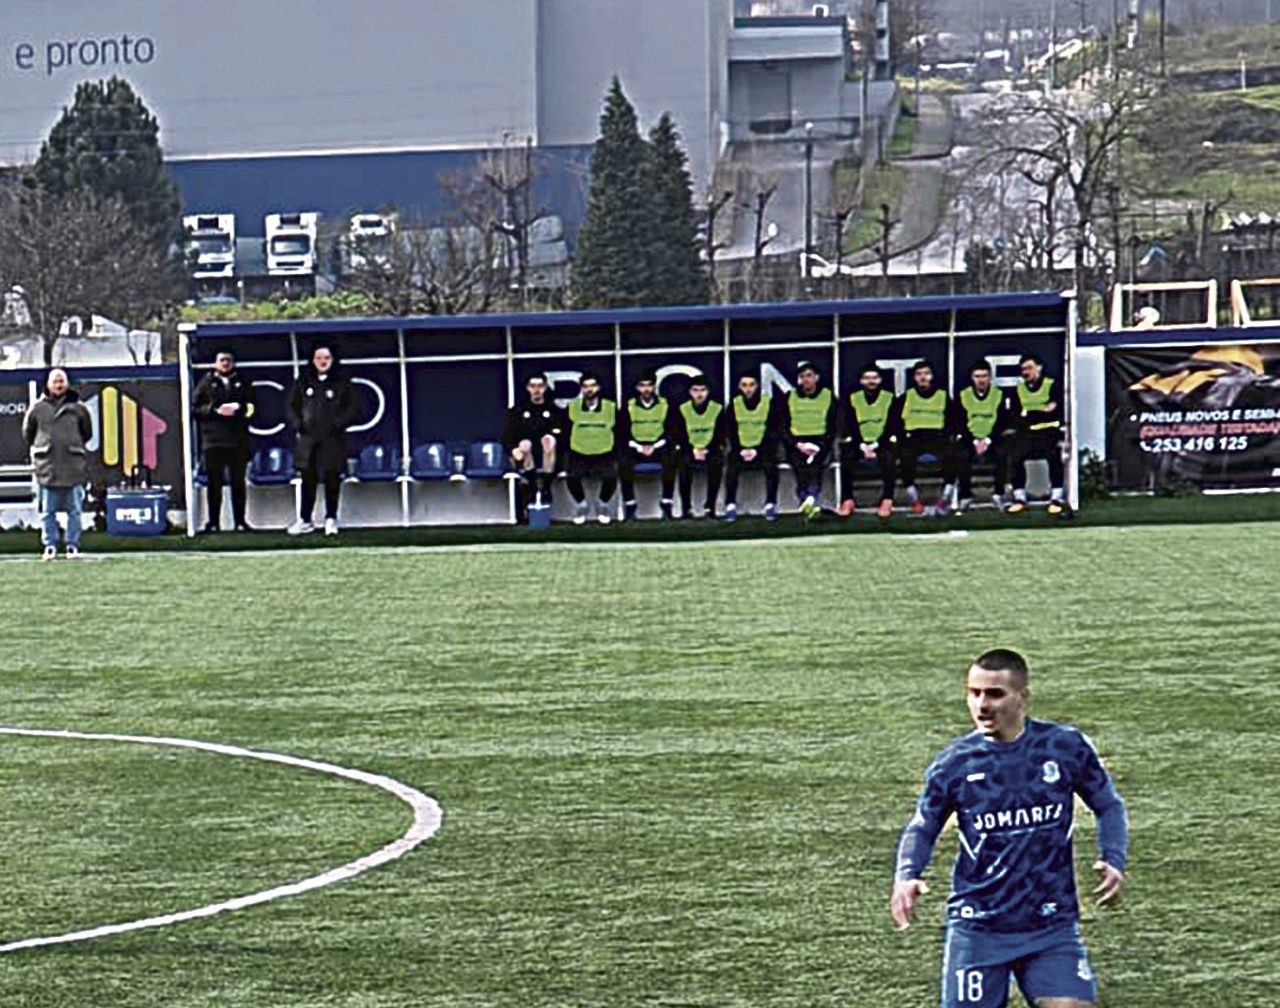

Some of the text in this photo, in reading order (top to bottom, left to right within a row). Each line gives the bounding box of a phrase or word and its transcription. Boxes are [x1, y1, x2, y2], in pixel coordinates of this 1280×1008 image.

[15, 43, 34, 70] e
[47, 34, 155, 75] pronto
[1185, 410, 1229, 422] NOVOS
[1232, 409, 1241, 420] E
[1152, 436, 1248, 452] 253 416 125
[955, 970, 983, 1001] 18
